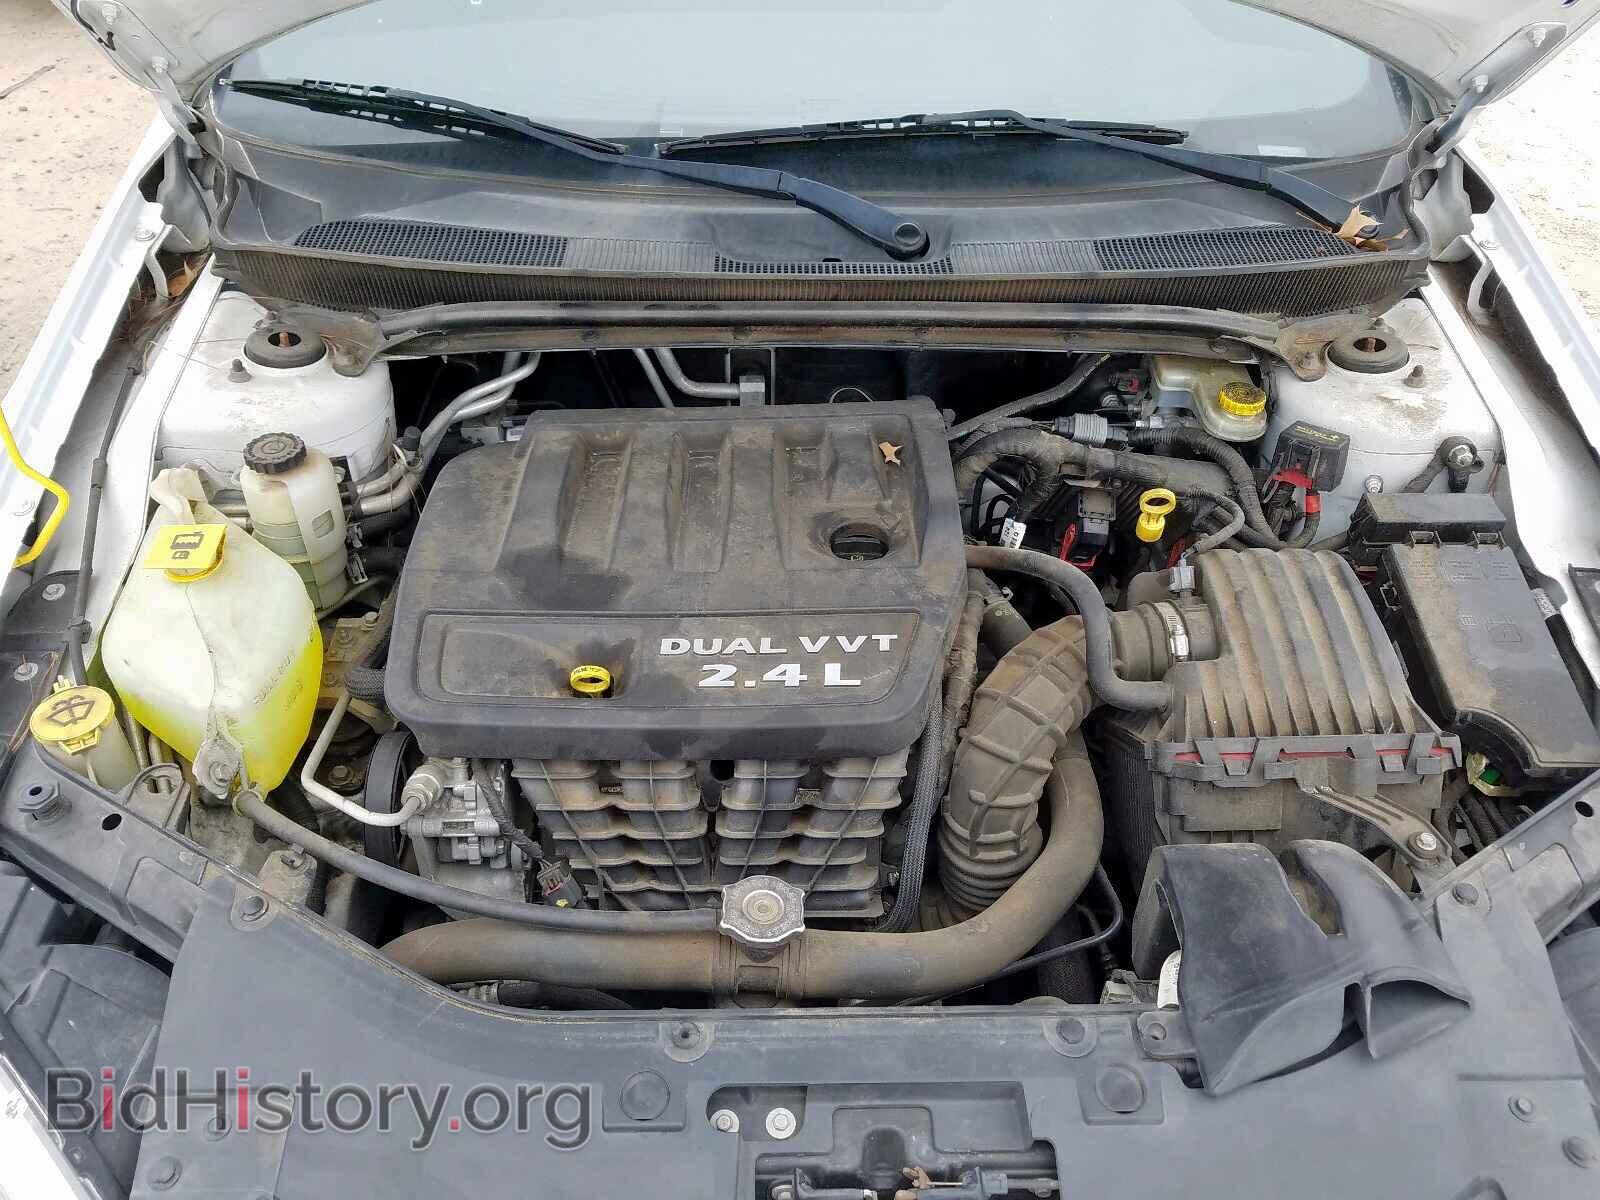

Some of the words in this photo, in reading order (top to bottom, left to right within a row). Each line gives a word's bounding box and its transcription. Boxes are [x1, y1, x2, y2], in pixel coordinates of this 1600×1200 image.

[659, 637, 788, 656] DUAL
[799, 634, 899, 653] VVT
[698, 663, 808, 688] 2.4
[823, 662, 862, 687] L
